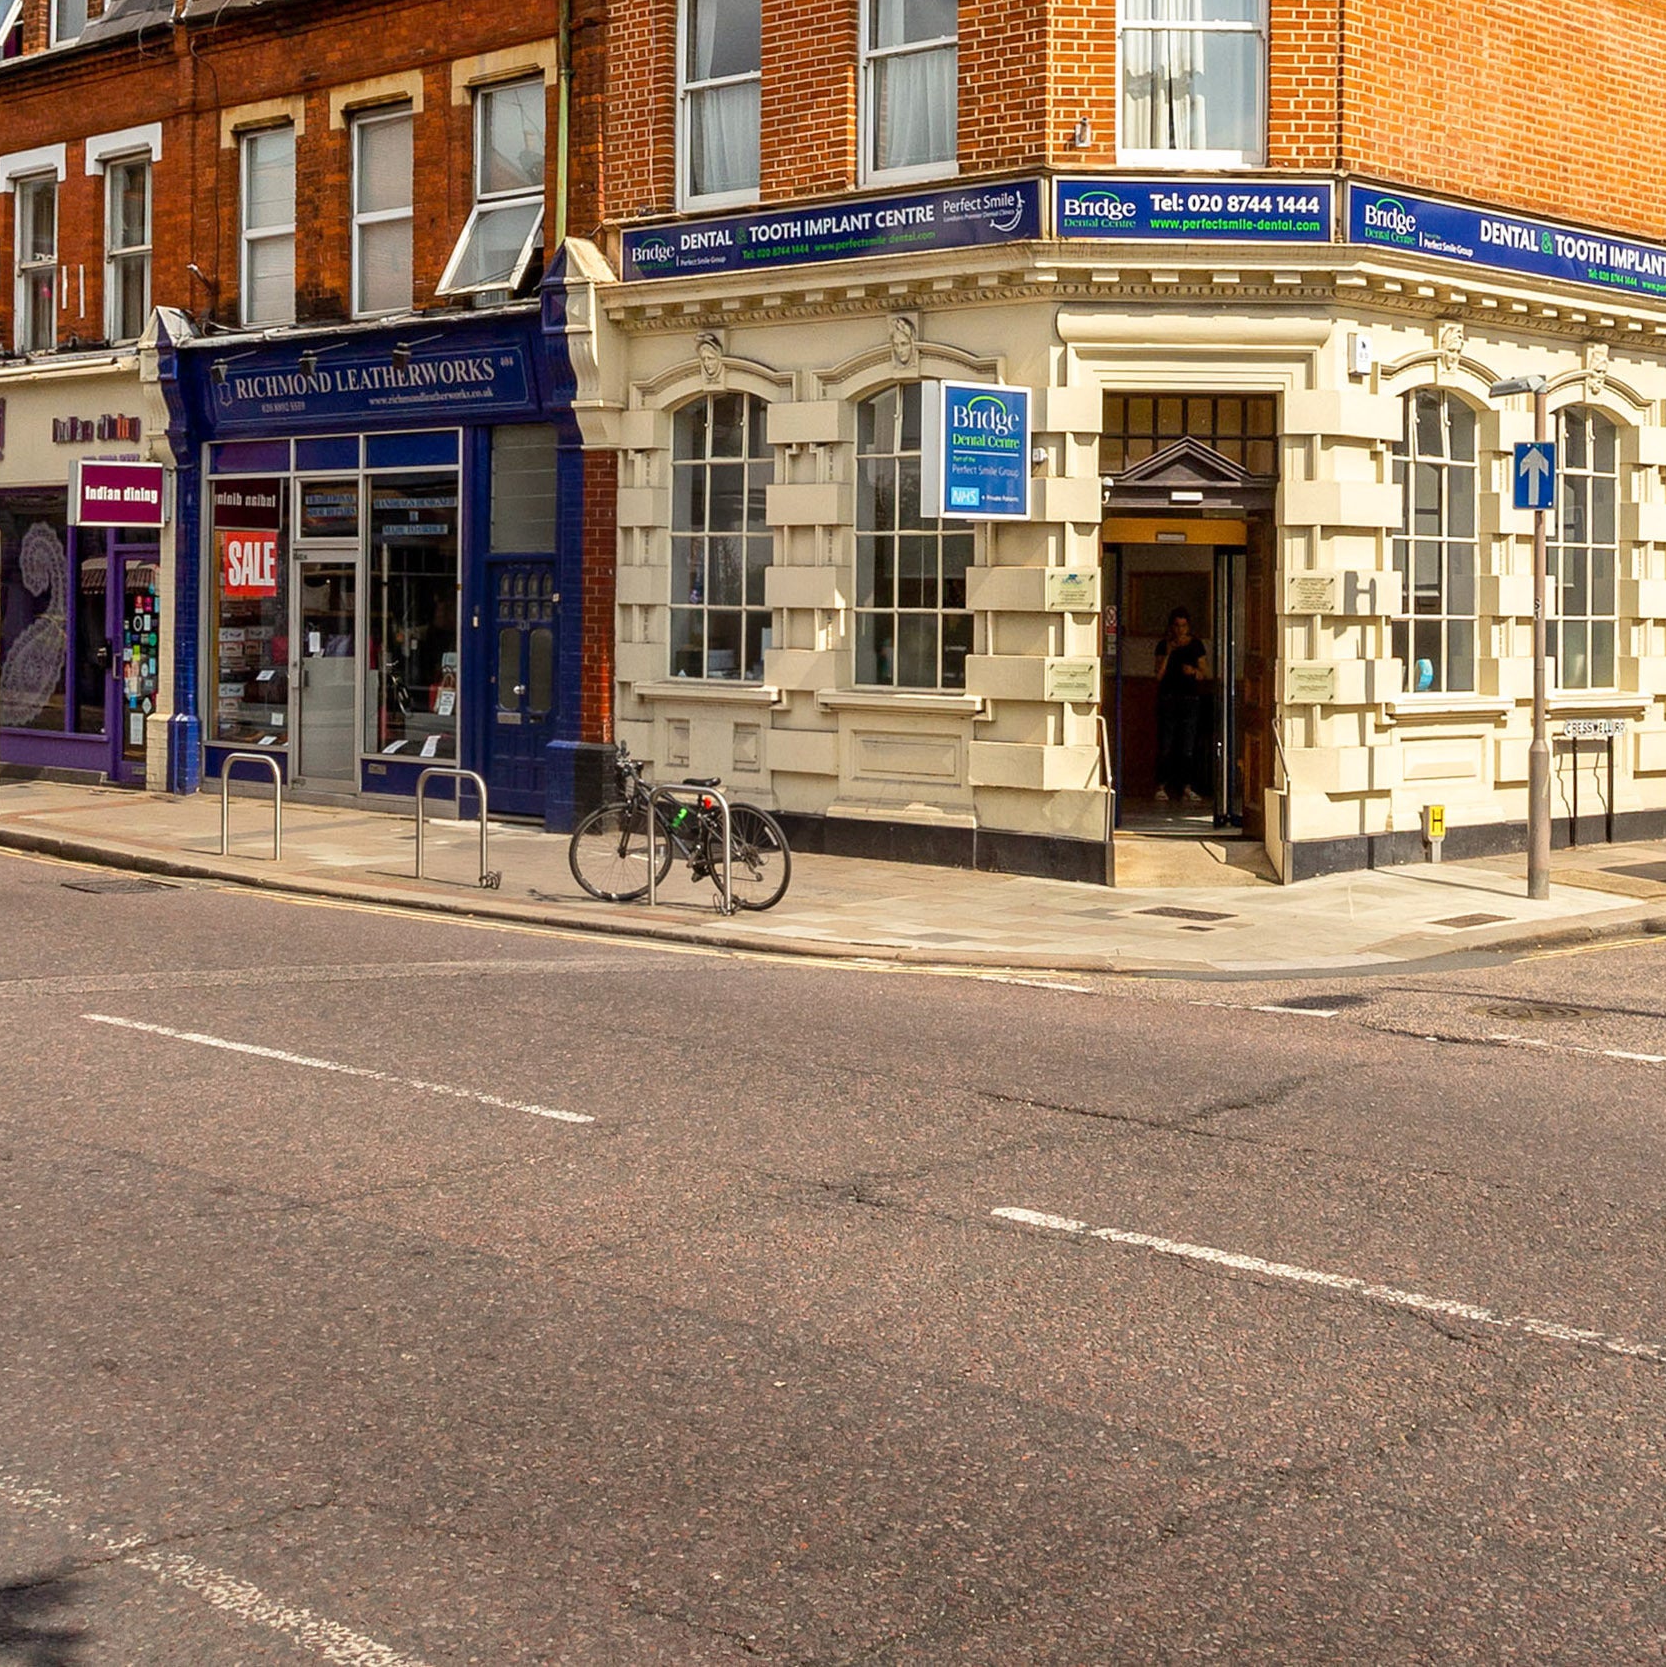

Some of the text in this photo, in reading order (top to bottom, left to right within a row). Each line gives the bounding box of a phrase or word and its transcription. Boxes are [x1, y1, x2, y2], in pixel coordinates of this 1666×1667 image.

[943, 193, 1015, 214] Perfect Smile
[1064, 197, 1136, 220] Bridge
[1150, 193, 1320, 214] Tel: 020 8744 1444
[680, 205, 935, 251] DENTAL & TOOTH IMPLANT CENTRE
[1063, 218, 1136, 229] Dental Centre
[1150, 218, 1320, 232] www.perfectsmile-dental.com
[1365, 204, 1416, 235] Bridge
[632, 243, 675, 263] Bridge
[1480, 219, 1539, 252] DENTAL
[1541, 231, 1553, 254] &
[1554, 234, 1607, 265] TOOTH
[236, 358, 495, 399] RICHMOND LEATHERWORKS
[53, 413, 141, 443] Indian dining
[953, 404, 1019, 435] Bridge
[953, 433, 1020, 449] Dental Centre
[952, 463, 1020, 479] Perfect Smile Group
[85, 485, 158, 504] Indian dining
[952, 488, 977, 504] NHS
[228, 541, 276, 587] SALE
[1432, 808, 1443, 832] H
